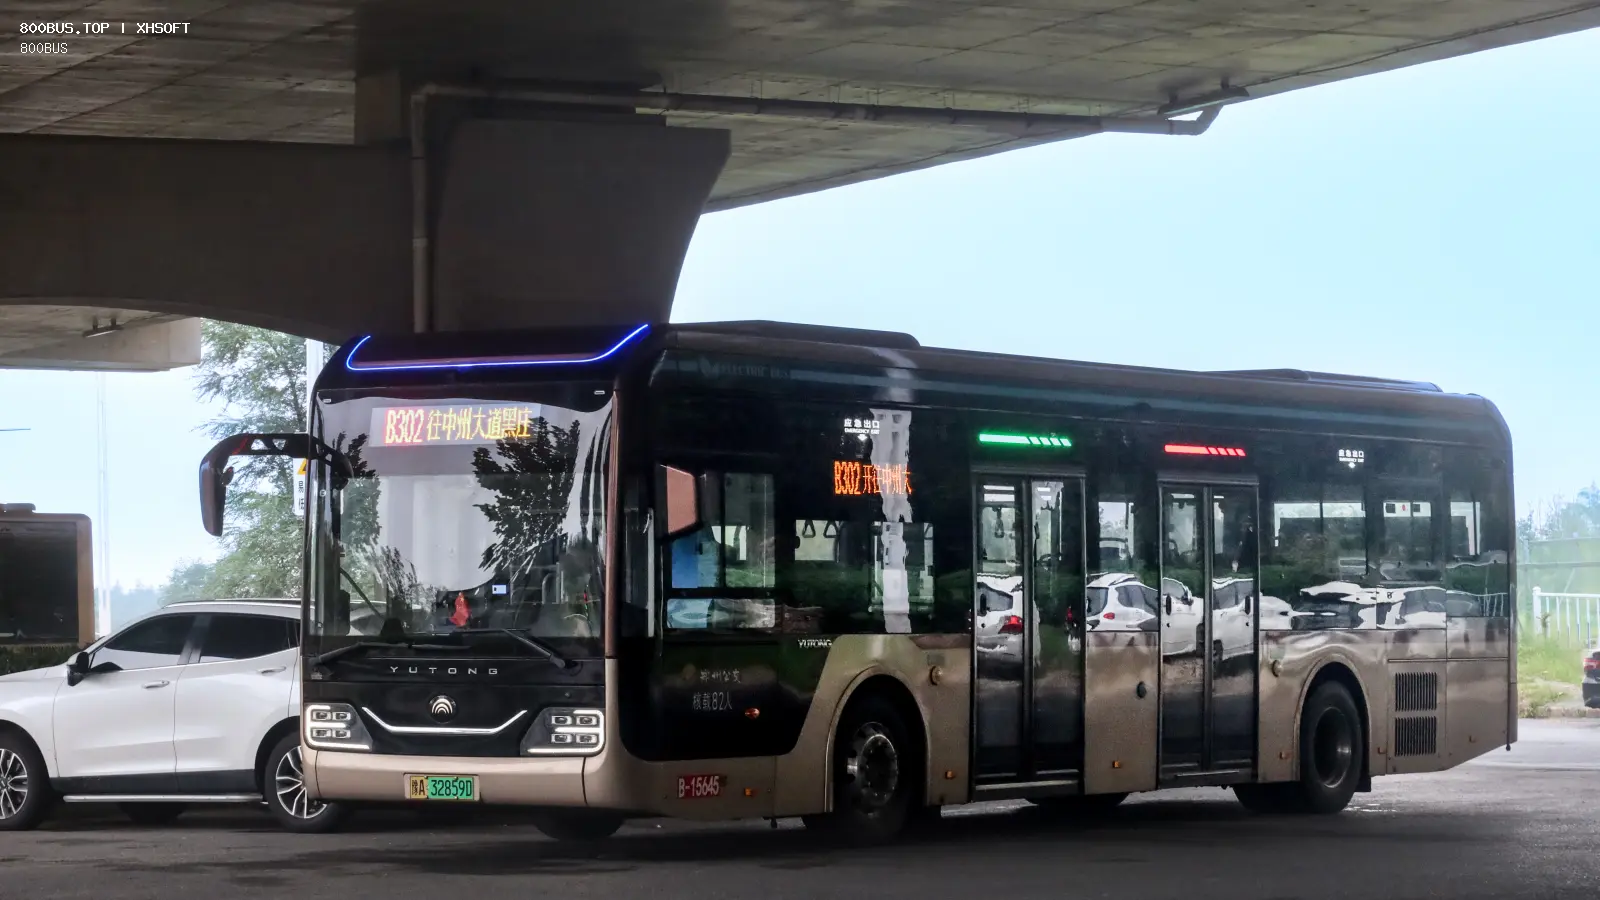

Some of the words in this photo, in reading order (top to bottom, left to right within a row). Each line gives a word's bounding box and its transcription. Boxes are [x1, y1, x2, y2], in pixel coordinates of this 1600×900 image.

[385, 408, 425, 444] B302
[427, 406, 533, 441] 往中州大道黑庄
[834, 460, 861, 495] B302
[797, 638, 832, 649] YUTONG
[390, 665, 498, 675] YUTONG
[678, 775, 720, 798] B-15645
